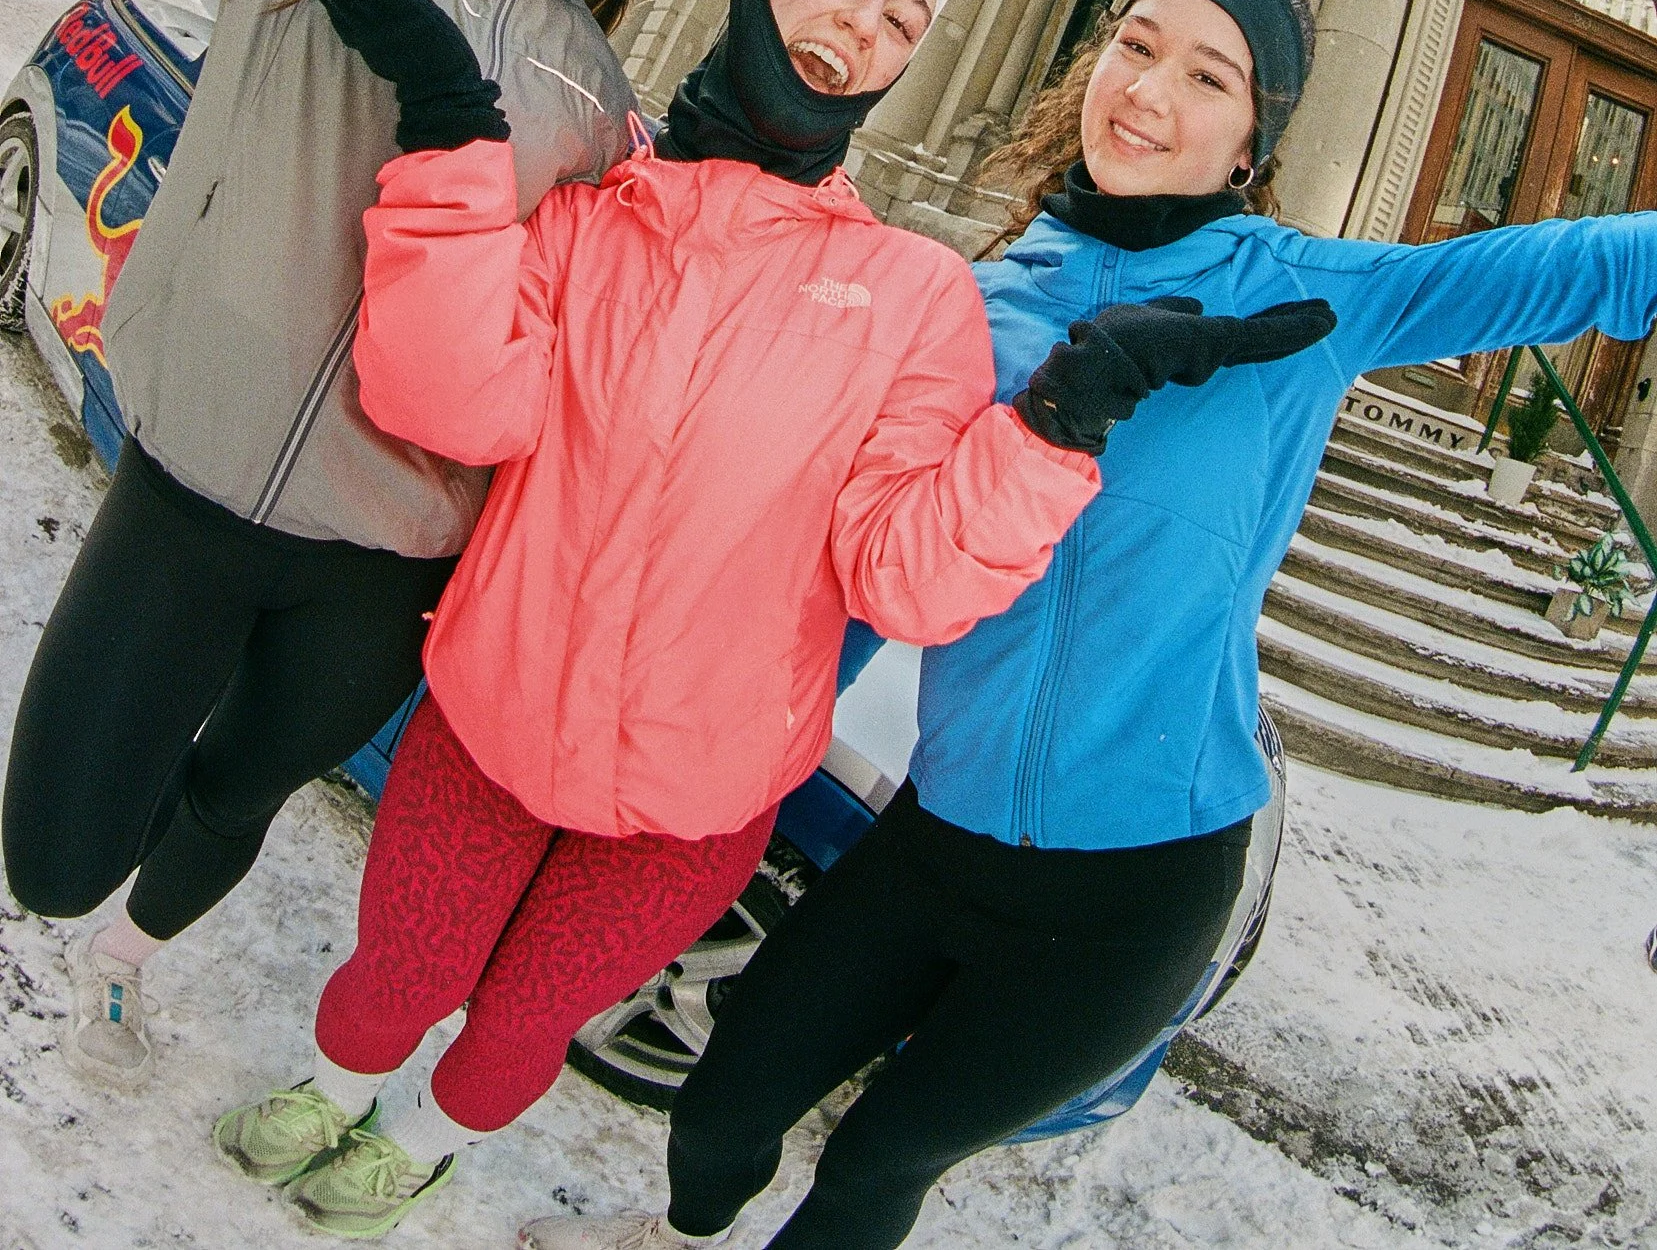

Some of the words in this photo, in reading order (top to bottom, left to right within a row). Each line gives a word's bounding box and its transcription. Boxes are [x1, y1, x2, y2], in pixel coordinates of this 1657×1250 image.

[798, 283, 848, 300] NORTH
[821, 276, 848, 292] THE
[810, 293, 847, 309] FACE
[1344, 395, 1465, 449] TOMMY
